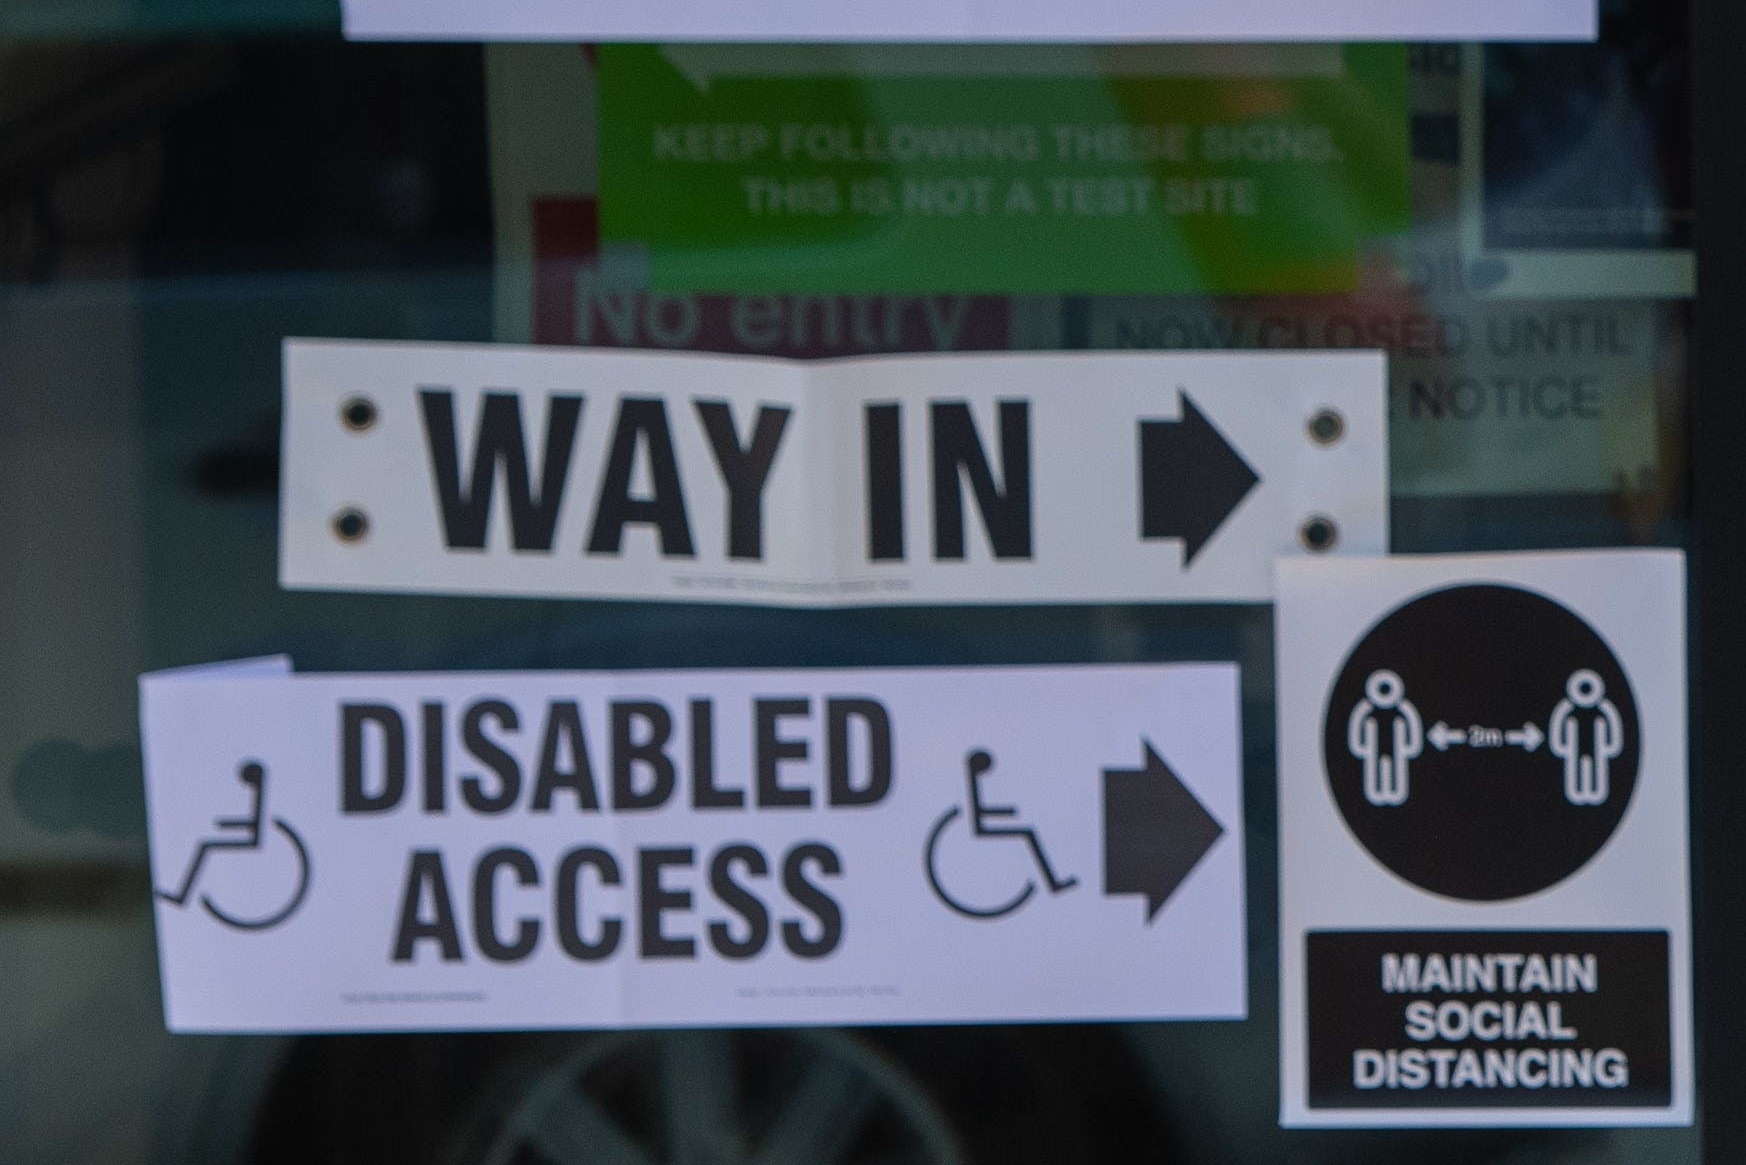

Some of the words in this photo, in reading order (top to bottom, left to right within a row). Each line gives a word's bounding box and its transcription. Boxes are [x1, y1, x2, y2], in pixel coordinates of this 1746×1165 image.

[653, 125, 768, 162] KEEP
[780, 125, 1037, 163] FOLLOWING
[1048, 125, 1186, 163] THESE
[741, 179, 837, 216] THIS
[852, 180, 893, 216] IS
[901, 179, 993, 217] NOT
[1003, 179, 1037, 217] A
[1045, 179, 1151, 217] TEST
[1163, 179, 1254, 217] SITE
[573, 269, 695, 345] No
[729, 295, 970, 350] entry
[1112, 319, 1240, 350] NOW
[1255, 315, 1462, 356] CLOSED
[1484, 307, 1633, 358] UNTIL
[1408, 374, 1604, 423] NOTICE
[416, 387, 793, 562] WAY
[863, 398, 1035, 564] IN
[339, 695, 895, 817] DISABLED
[1468, 724, 1503, 748] 2m
[390, 840, 845, 965] ACCESS
[1380, 953, 1599, 993] MAINTAIN
[1404, 1000, 1579, 1041] SOCIAL
[1352, 1047, 1630, 1090] DISTANCING
